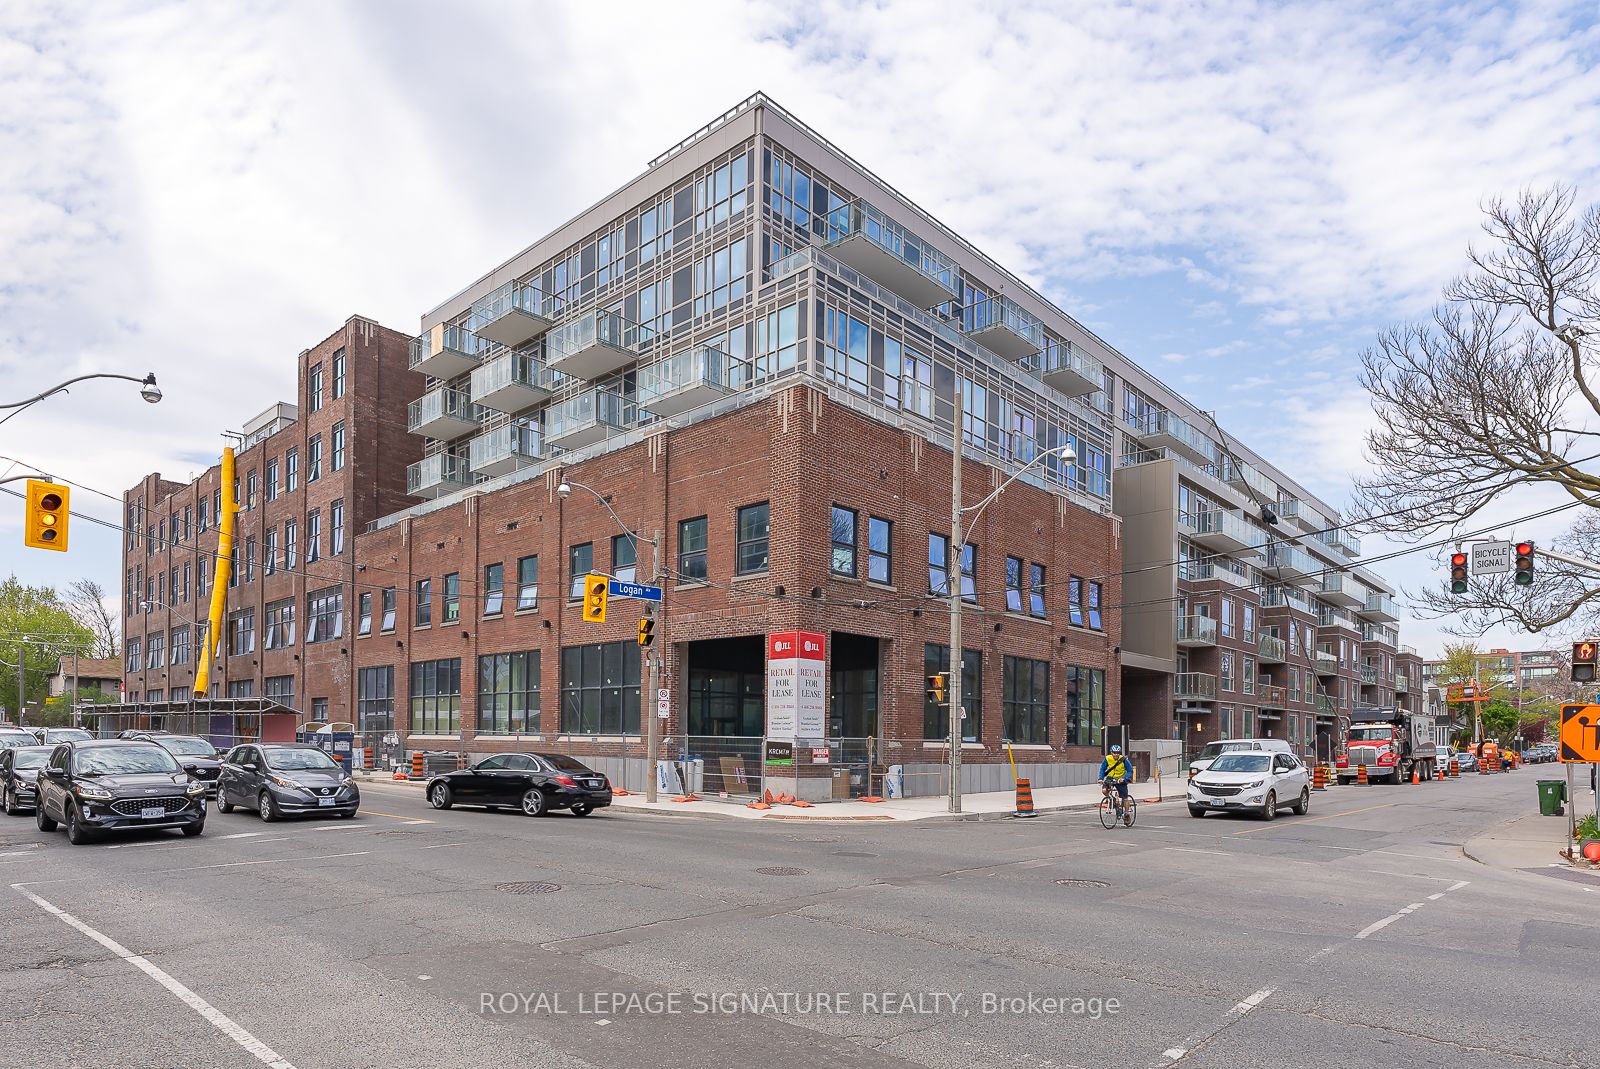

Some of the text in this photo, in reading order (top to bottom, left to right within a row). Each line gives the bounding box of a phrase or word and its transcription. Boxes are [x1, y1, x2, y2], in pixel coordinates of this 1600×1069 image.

[1475, 548, 1507, 558] BICYCLE
[1477, 558, 1505, 568] SIGNAL
[619, 583, 643, 596] Logan
[770, 668, 796, 677] RETAIL
[800, 668, 823, 678] RETAIL
[775, 679, 790, 687] FOR
[805, 679, 818, 688] FOR
[772, 689, 794, 697] LEASE
[801, 690, 822, 698] LEASE
